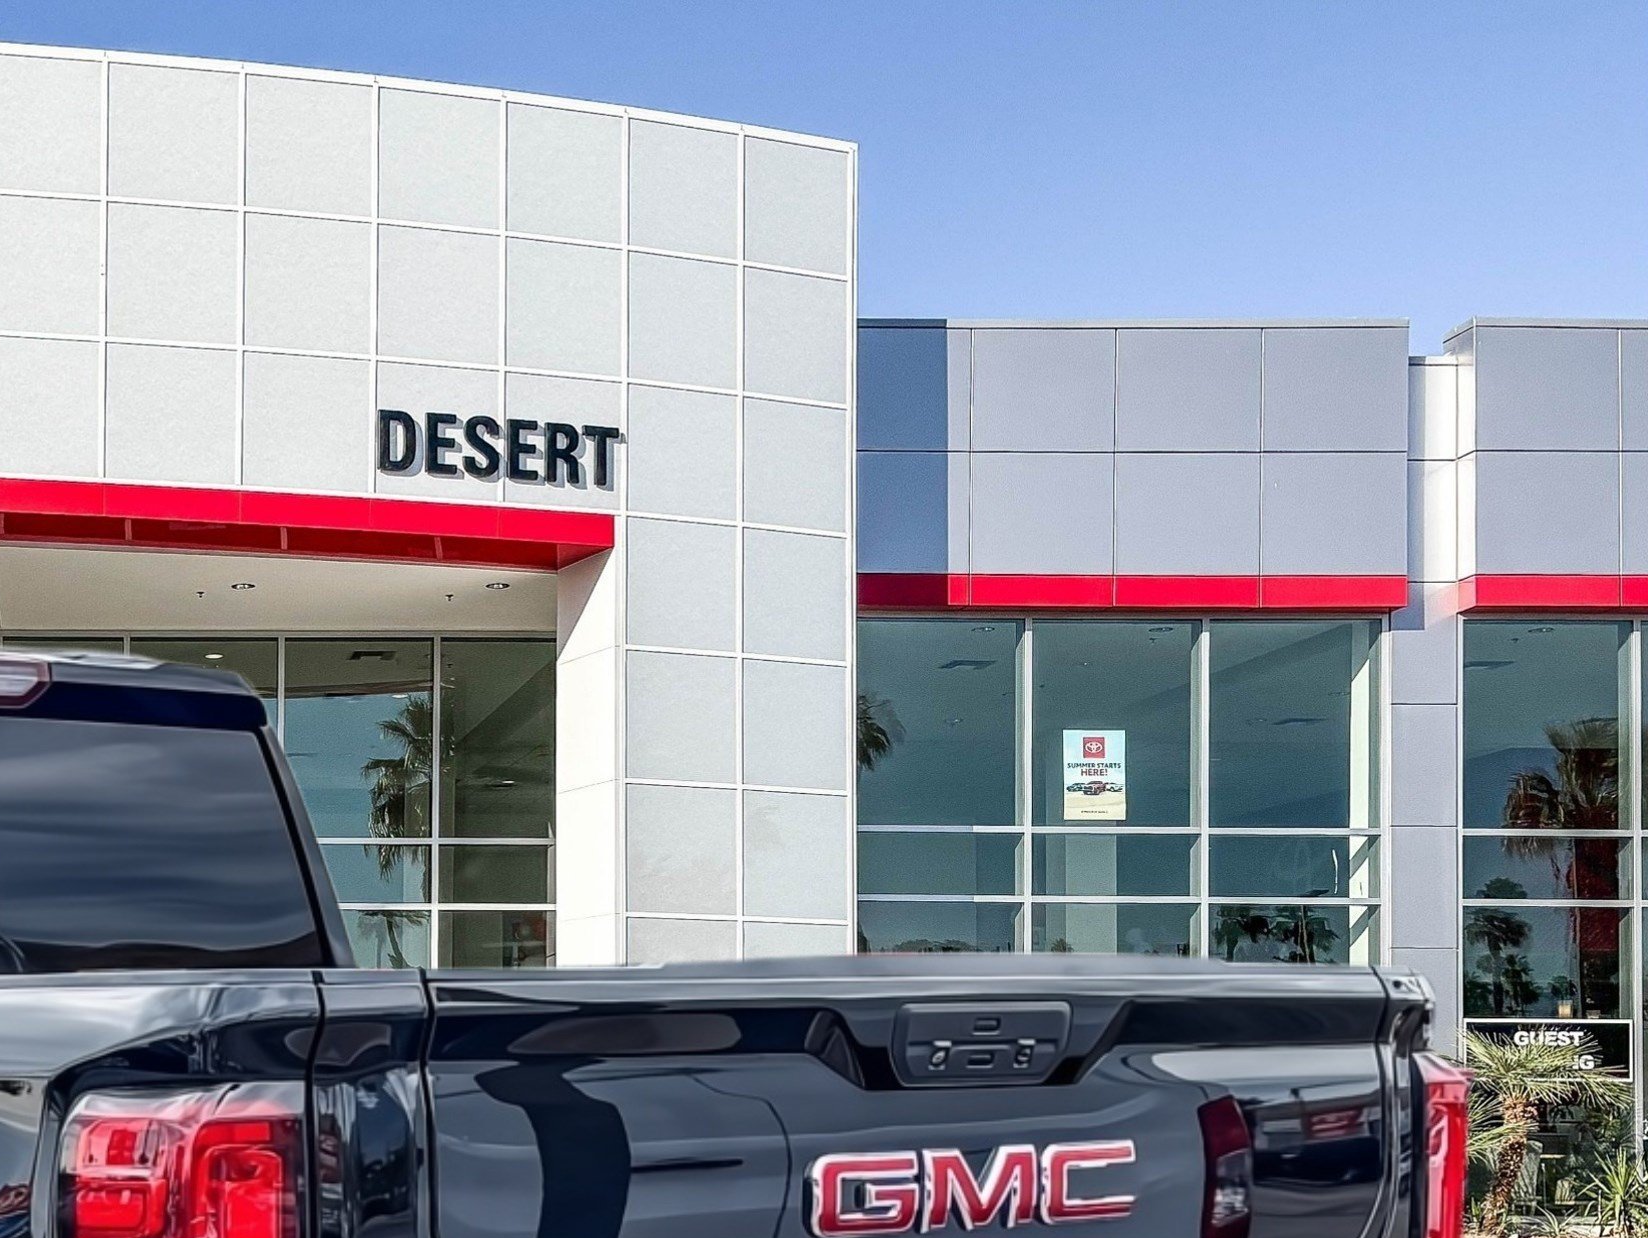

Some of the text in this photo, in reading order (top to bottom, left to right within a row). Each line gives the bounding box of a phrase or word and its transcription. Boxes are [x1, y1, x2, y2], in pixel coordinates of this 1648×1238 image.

[377, 409, 620, 487] DESERT
[1080, 768, 1108, 777] HERE!
[1513, 1031, 1584, 1047] GUEST
